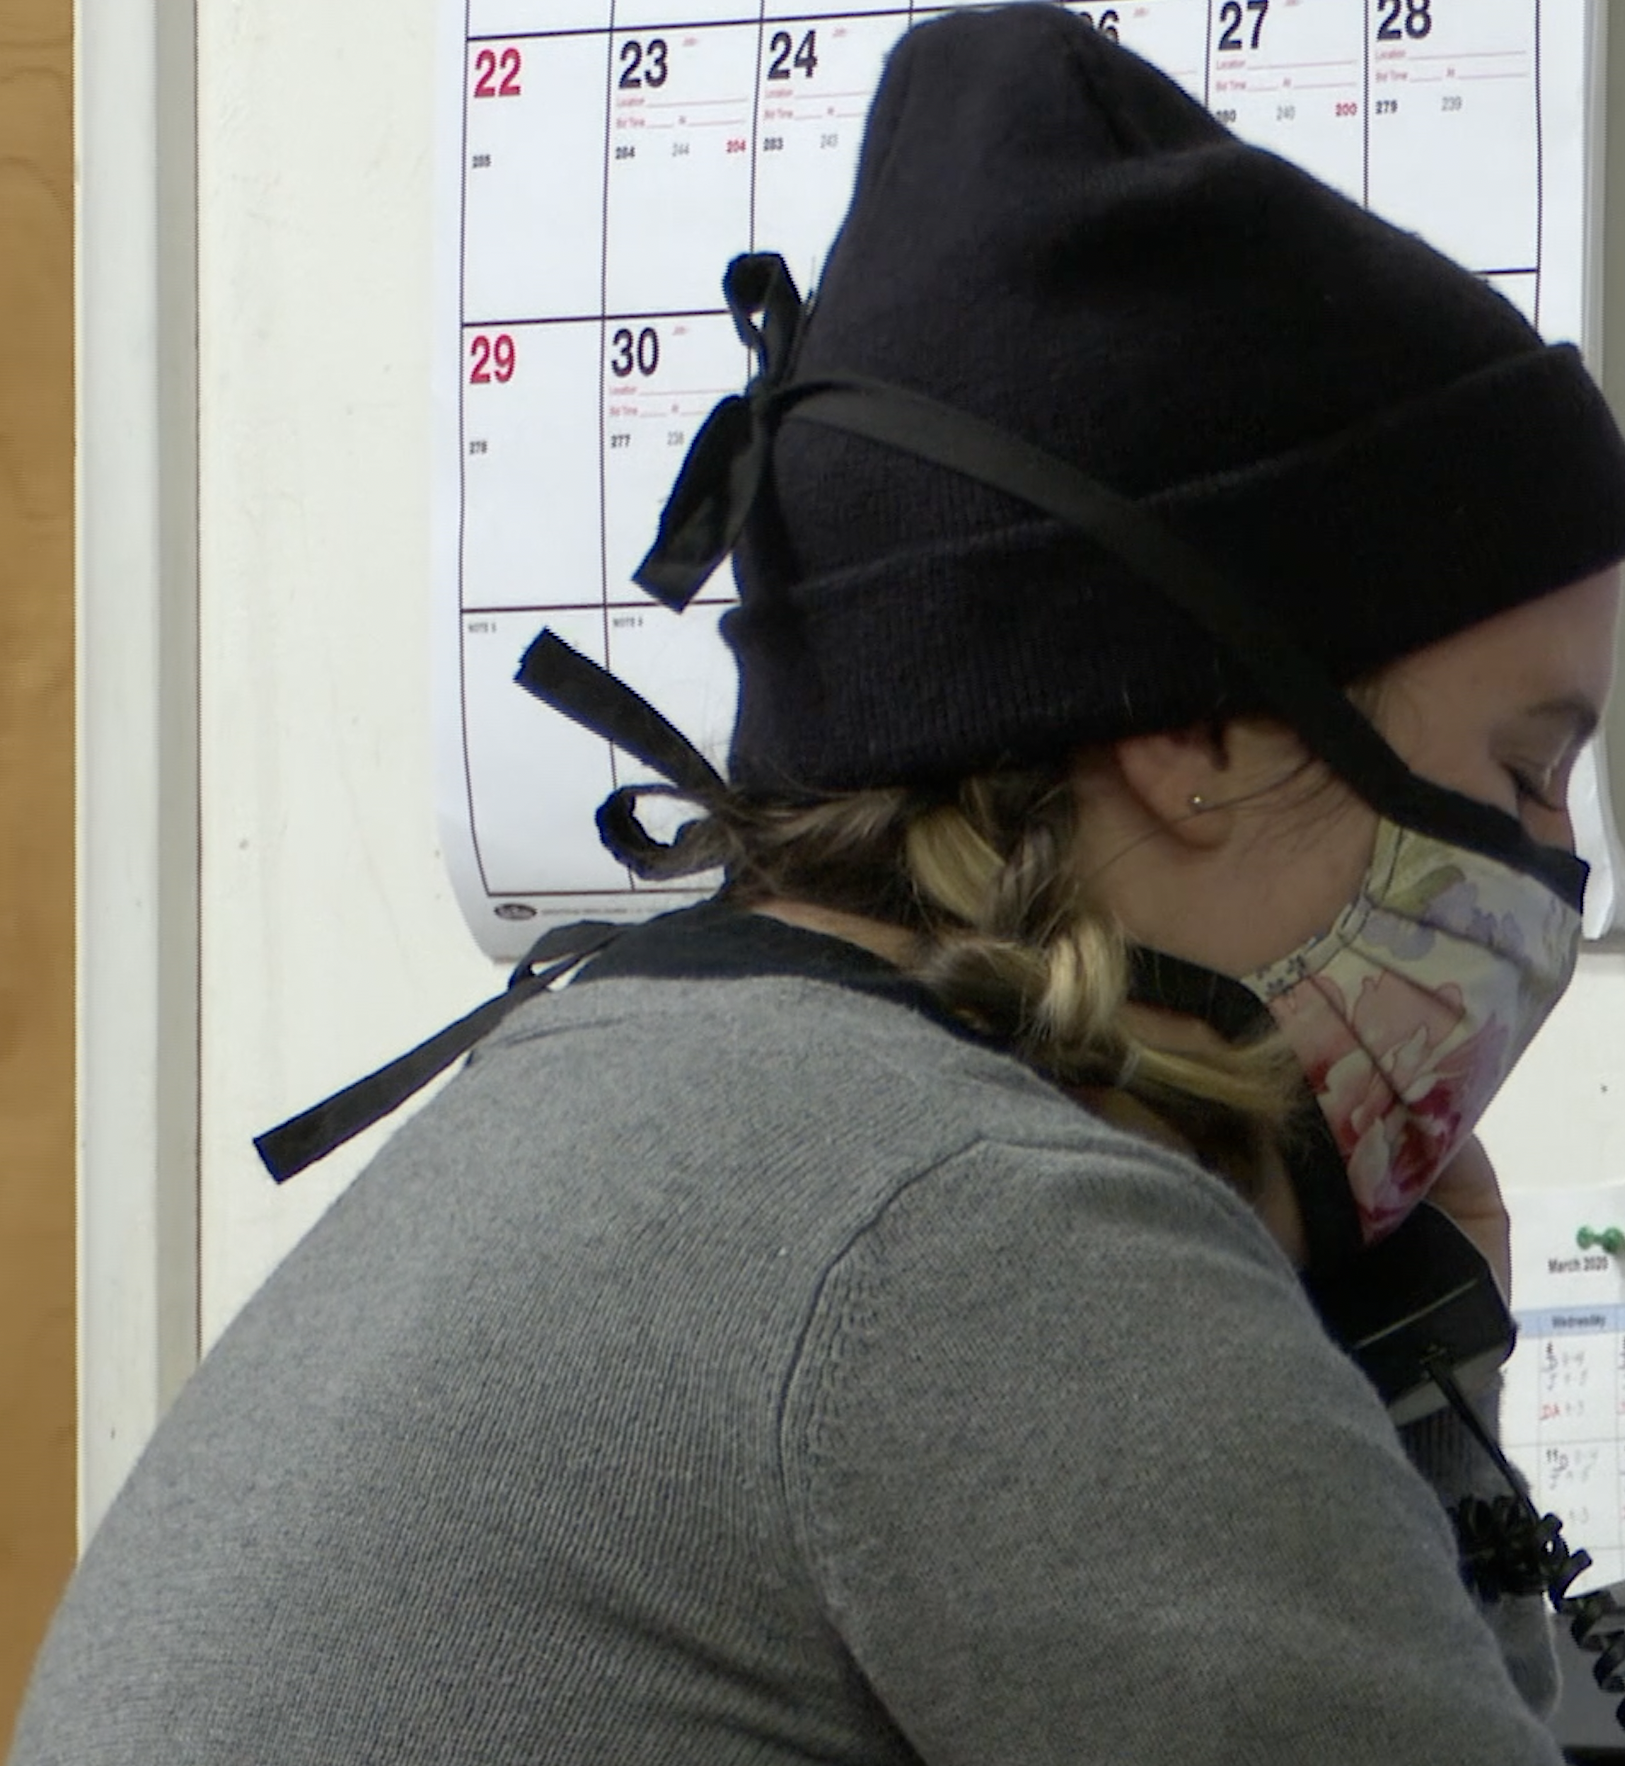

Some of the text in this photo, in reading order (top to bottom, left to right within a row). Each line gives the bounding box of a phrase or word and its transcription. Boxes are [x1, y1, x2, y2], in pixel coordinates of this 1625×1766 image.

[1218, 0, 1268, 50] 27
[1376, 0, 1432, 42] 28
[474, 48, 521, 98] 22
[618, 38, 668, 89] 23
[767, 29, 817, 80] 24
[470, 334, 515, 384] 29
[612, 327, 659, 377] 30
[611, 434, 631, 449] 277
[1548, 1254, 1608, 1274] March 2020
[1552, 1315, 1607, 1330] Wednesday
